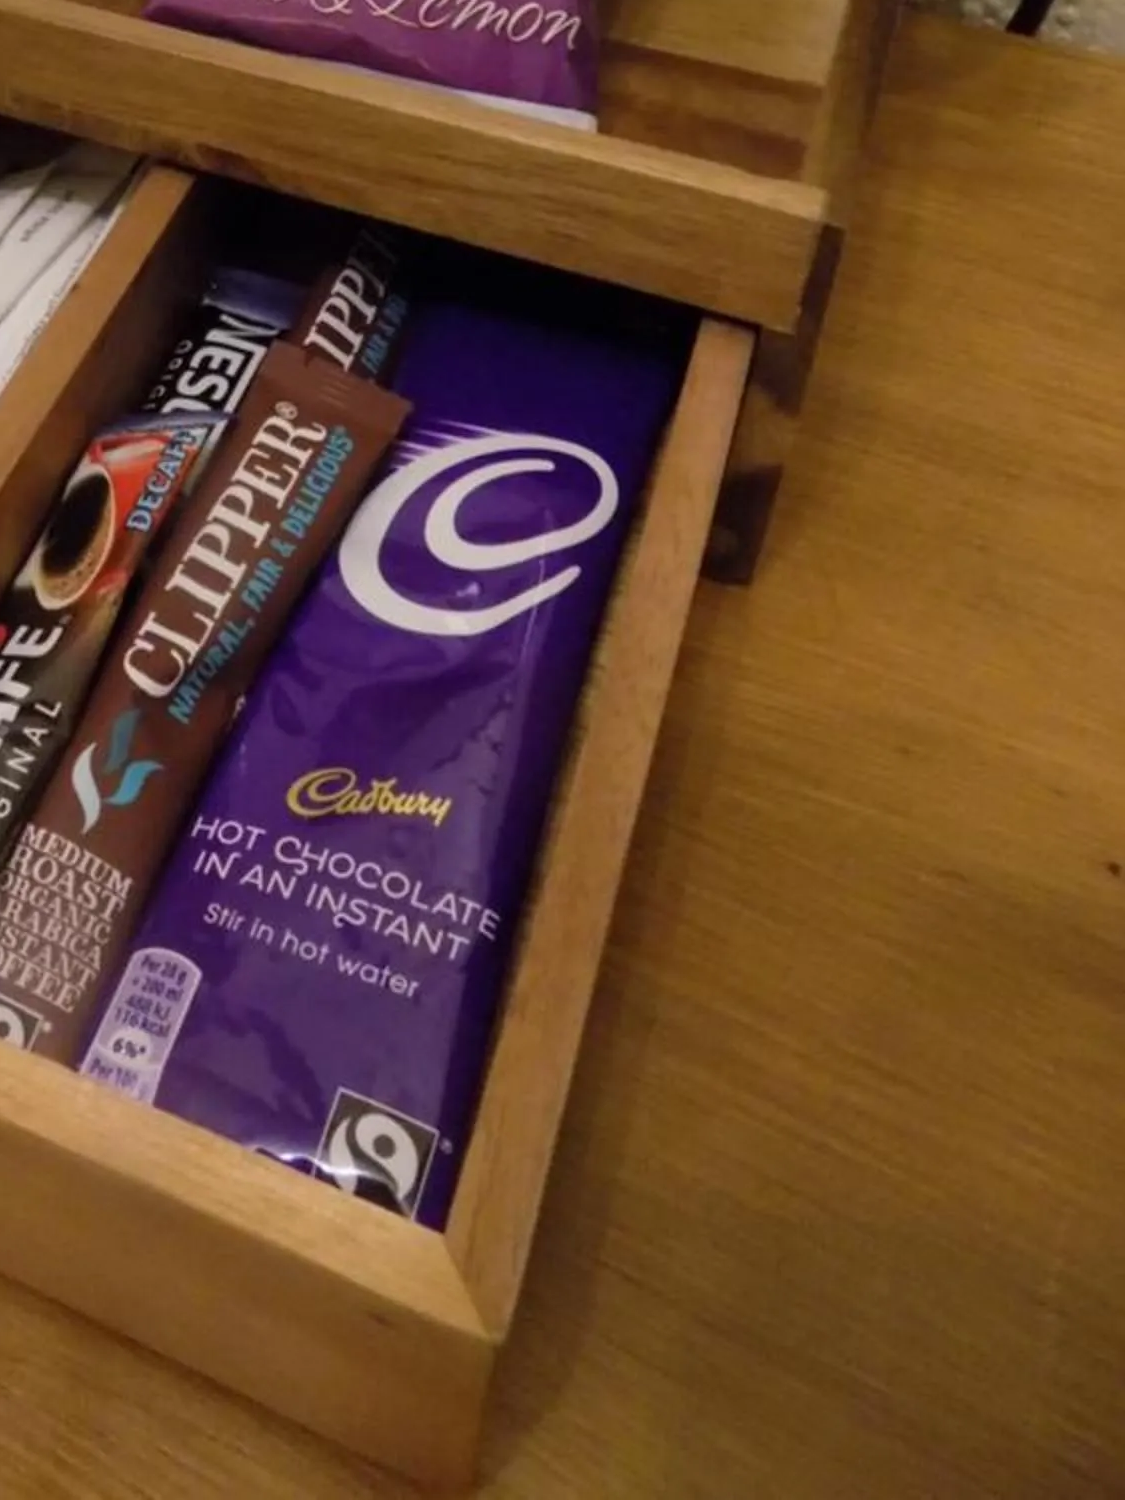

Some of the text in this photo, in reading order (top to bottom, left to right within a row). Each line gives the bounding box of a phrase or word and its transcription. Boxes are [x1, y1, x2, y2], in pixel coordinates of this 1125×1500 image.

[240, 556, 284, 613] FAIR
[286, 766, 452, 828] Cadbury
[8, 844, 126, 923] ROAST
[20, 822, 134, 900] MEDIUM
[191, 815, 502, 942] HOT CHOCOLATE
[192, 850, 471, 961] IN AN INSTANT
[249, 916, 275, 945] in
[280, 928, 331, 964] hot
[336, 953, 421, 999] water
